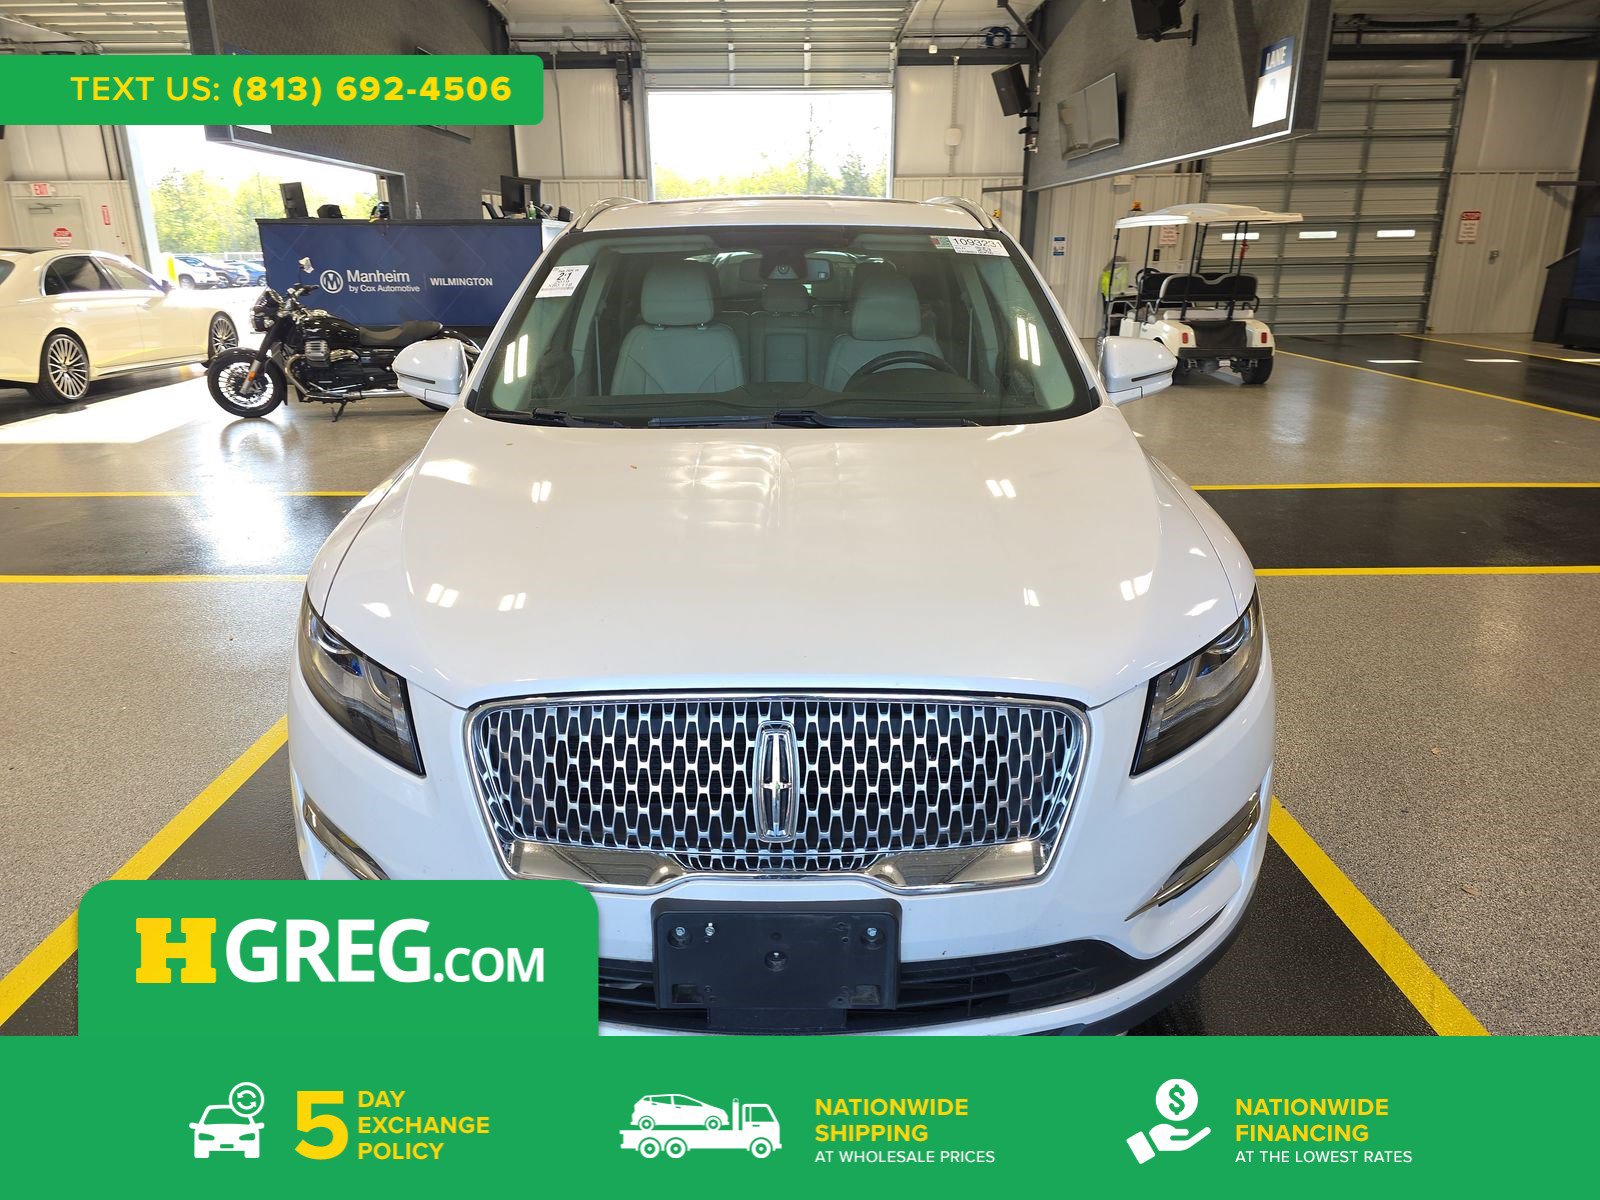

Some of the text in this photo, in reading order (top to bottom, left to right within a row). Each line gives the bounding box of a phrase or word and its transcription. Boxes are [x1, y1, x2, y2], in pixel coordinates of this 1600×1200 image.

[1265, 45, 1287, 71] LANE
[953, 238, 1003, 248] 1093231
[346, 270, 410, 283] Manheim
[430, 277, 494, 287] WILMINGTON
[348, 285, 359, 293] by
[377, 285, 421, 293] Automotive
